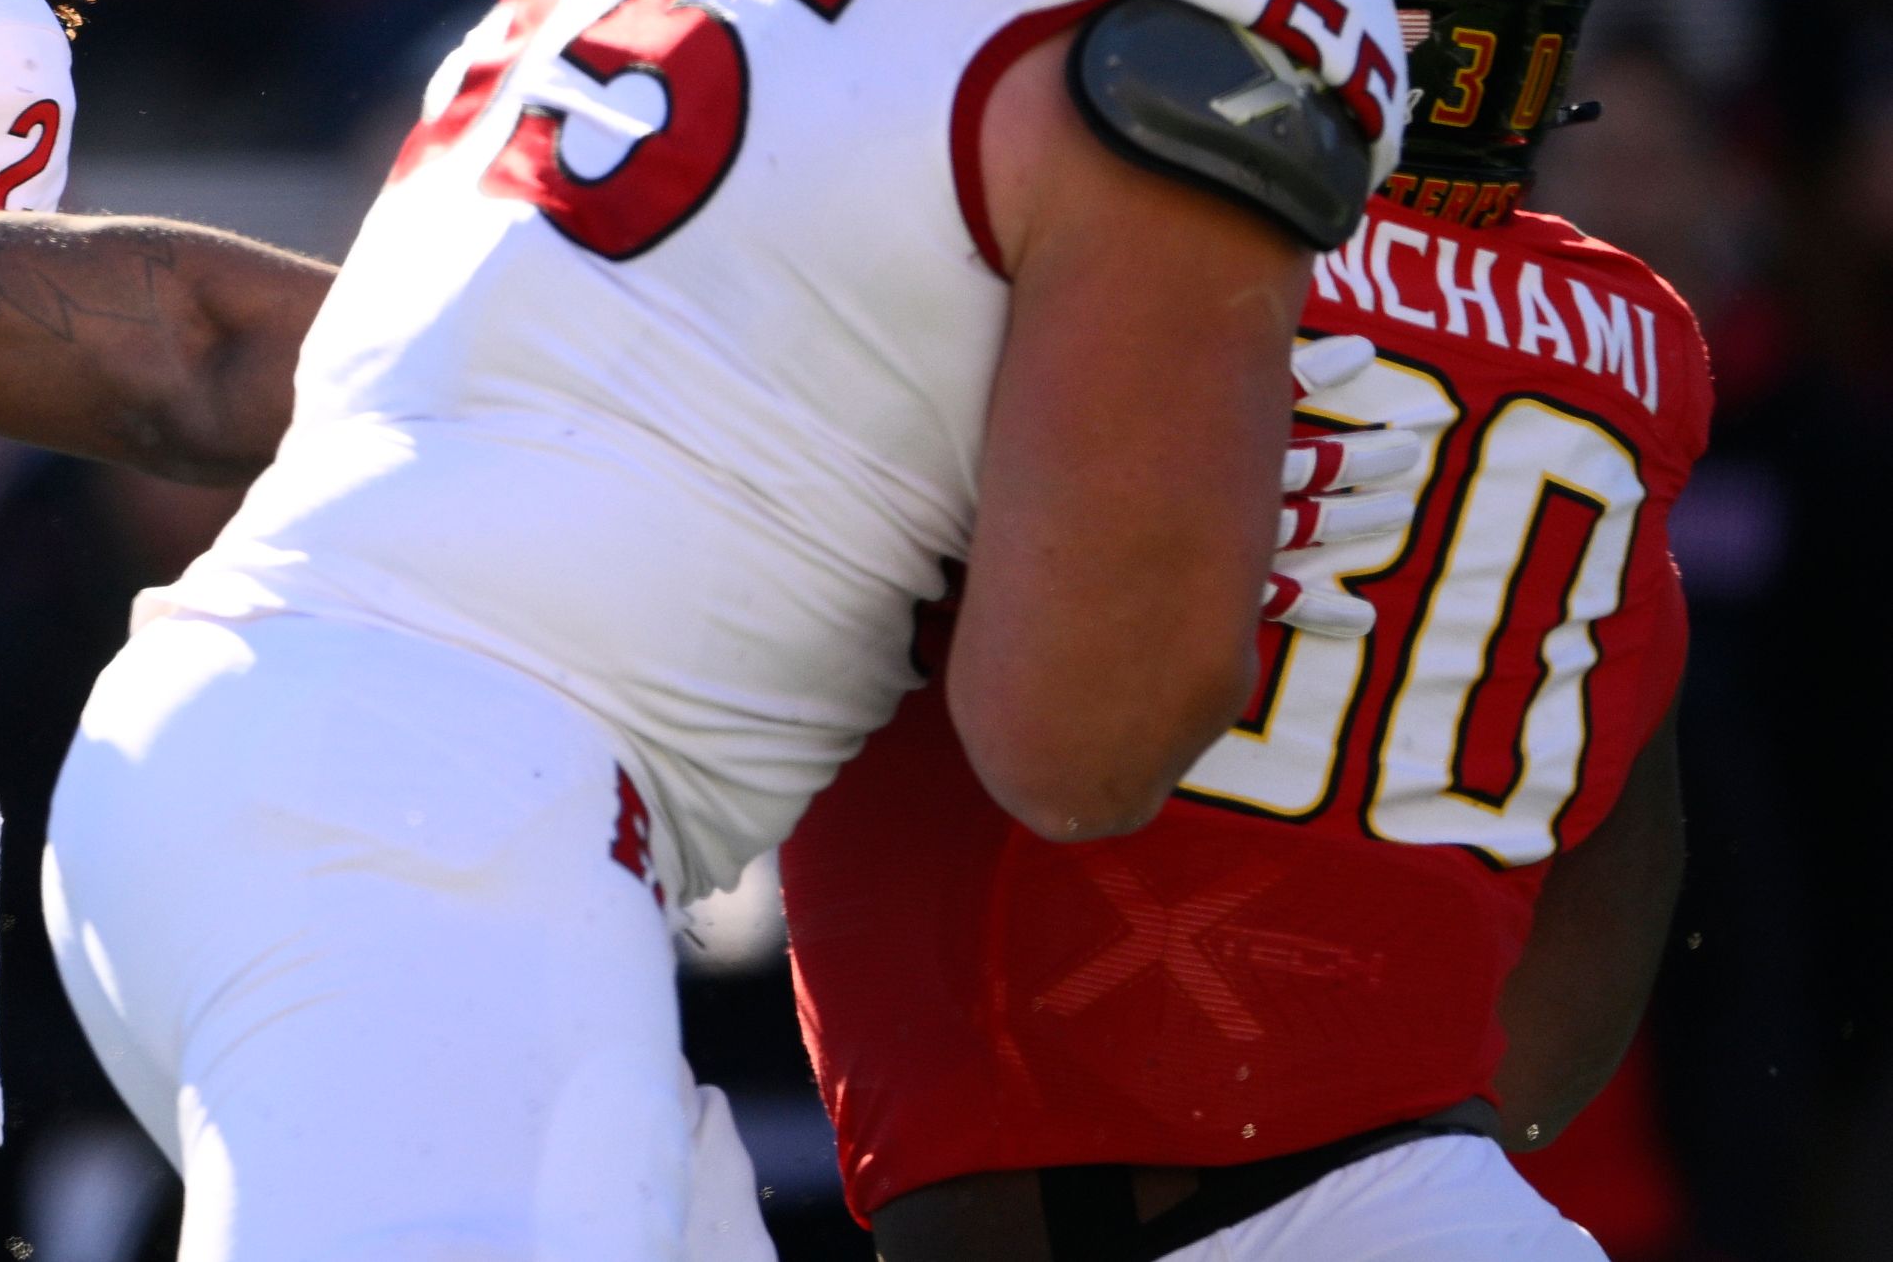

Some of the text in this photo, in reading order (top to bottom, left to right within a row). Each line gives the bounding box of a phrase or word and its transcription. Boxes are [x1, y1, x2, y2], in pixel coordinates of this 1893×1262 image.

[1429, 26, 1563, 130] 30
[1384, 172, 1522, 229] TERPS
[1312, 213, 1659, 416] NCHAMI
[1171, 325, 1648, 872] 30
